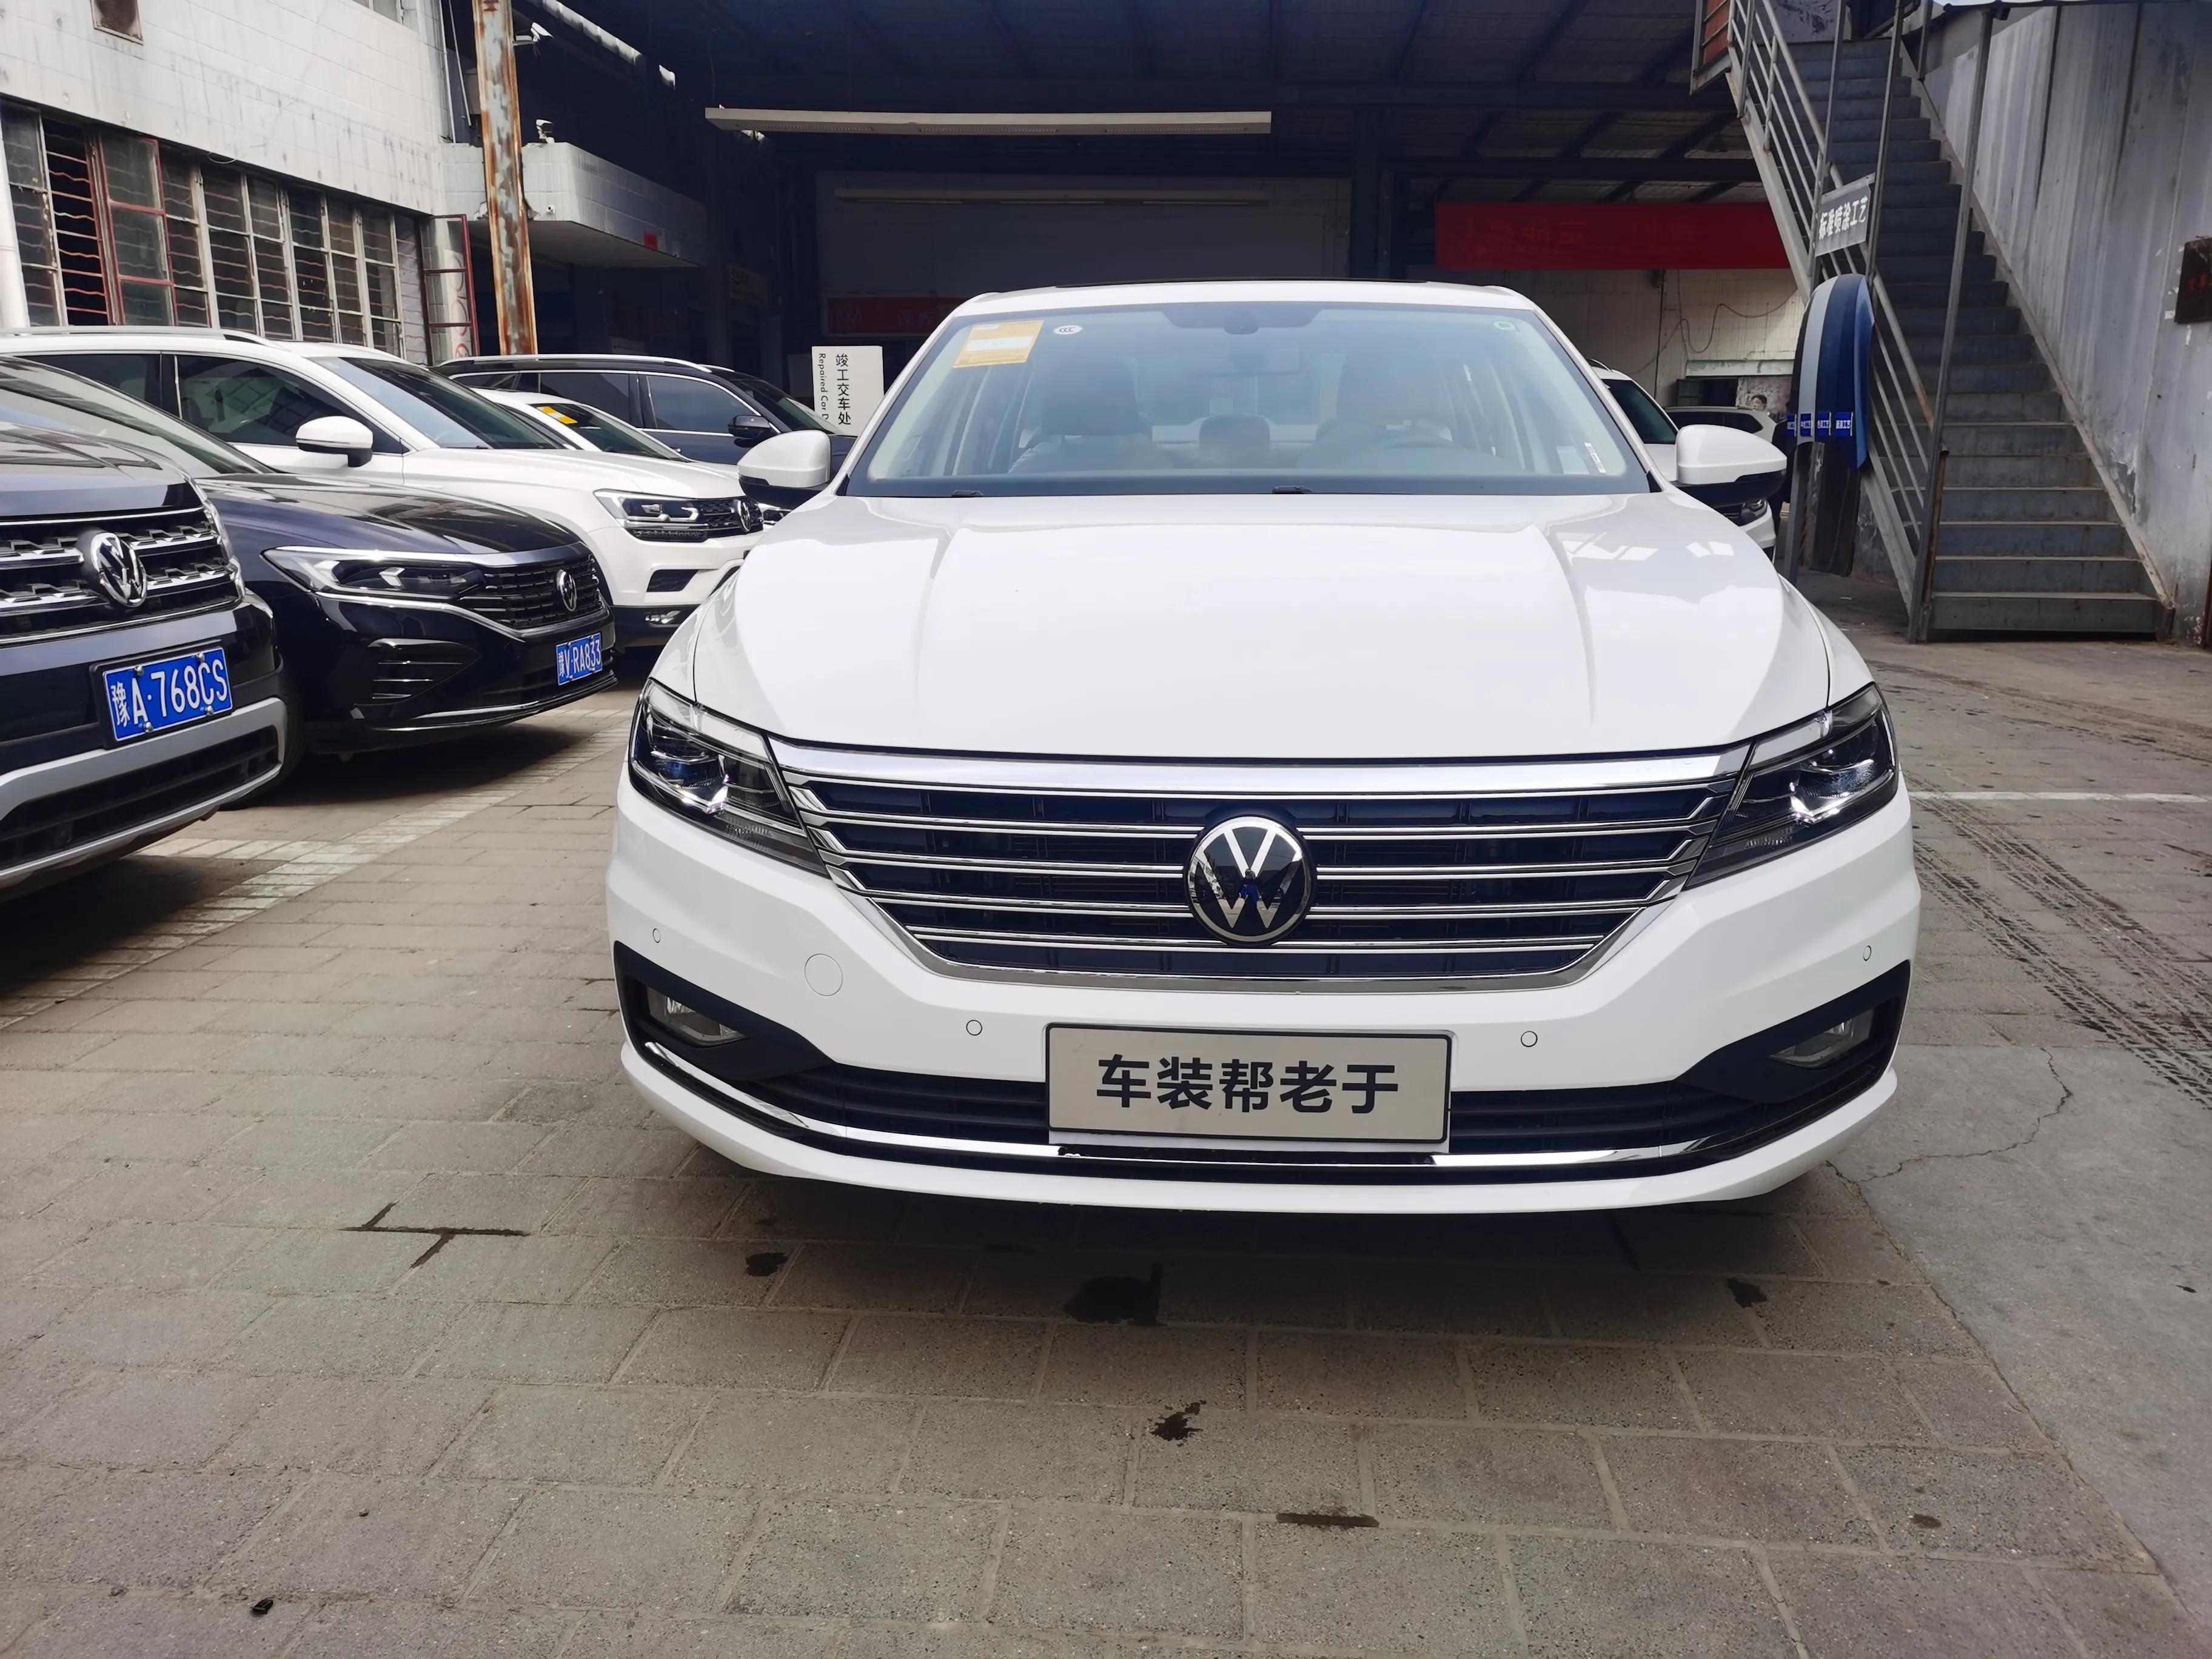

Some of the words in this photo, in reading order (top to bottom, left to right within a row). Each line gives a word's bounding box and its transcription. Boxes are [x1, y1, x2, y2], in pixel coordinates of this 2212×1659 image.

[1819, 196, 1868, 240] 标准喷涂工艺
[818, 353, 828, 393] Repaired
[836, 353, 851, 425] 竣工交车处
[1096, 1054, 1399, 1114] 车装帮老于
